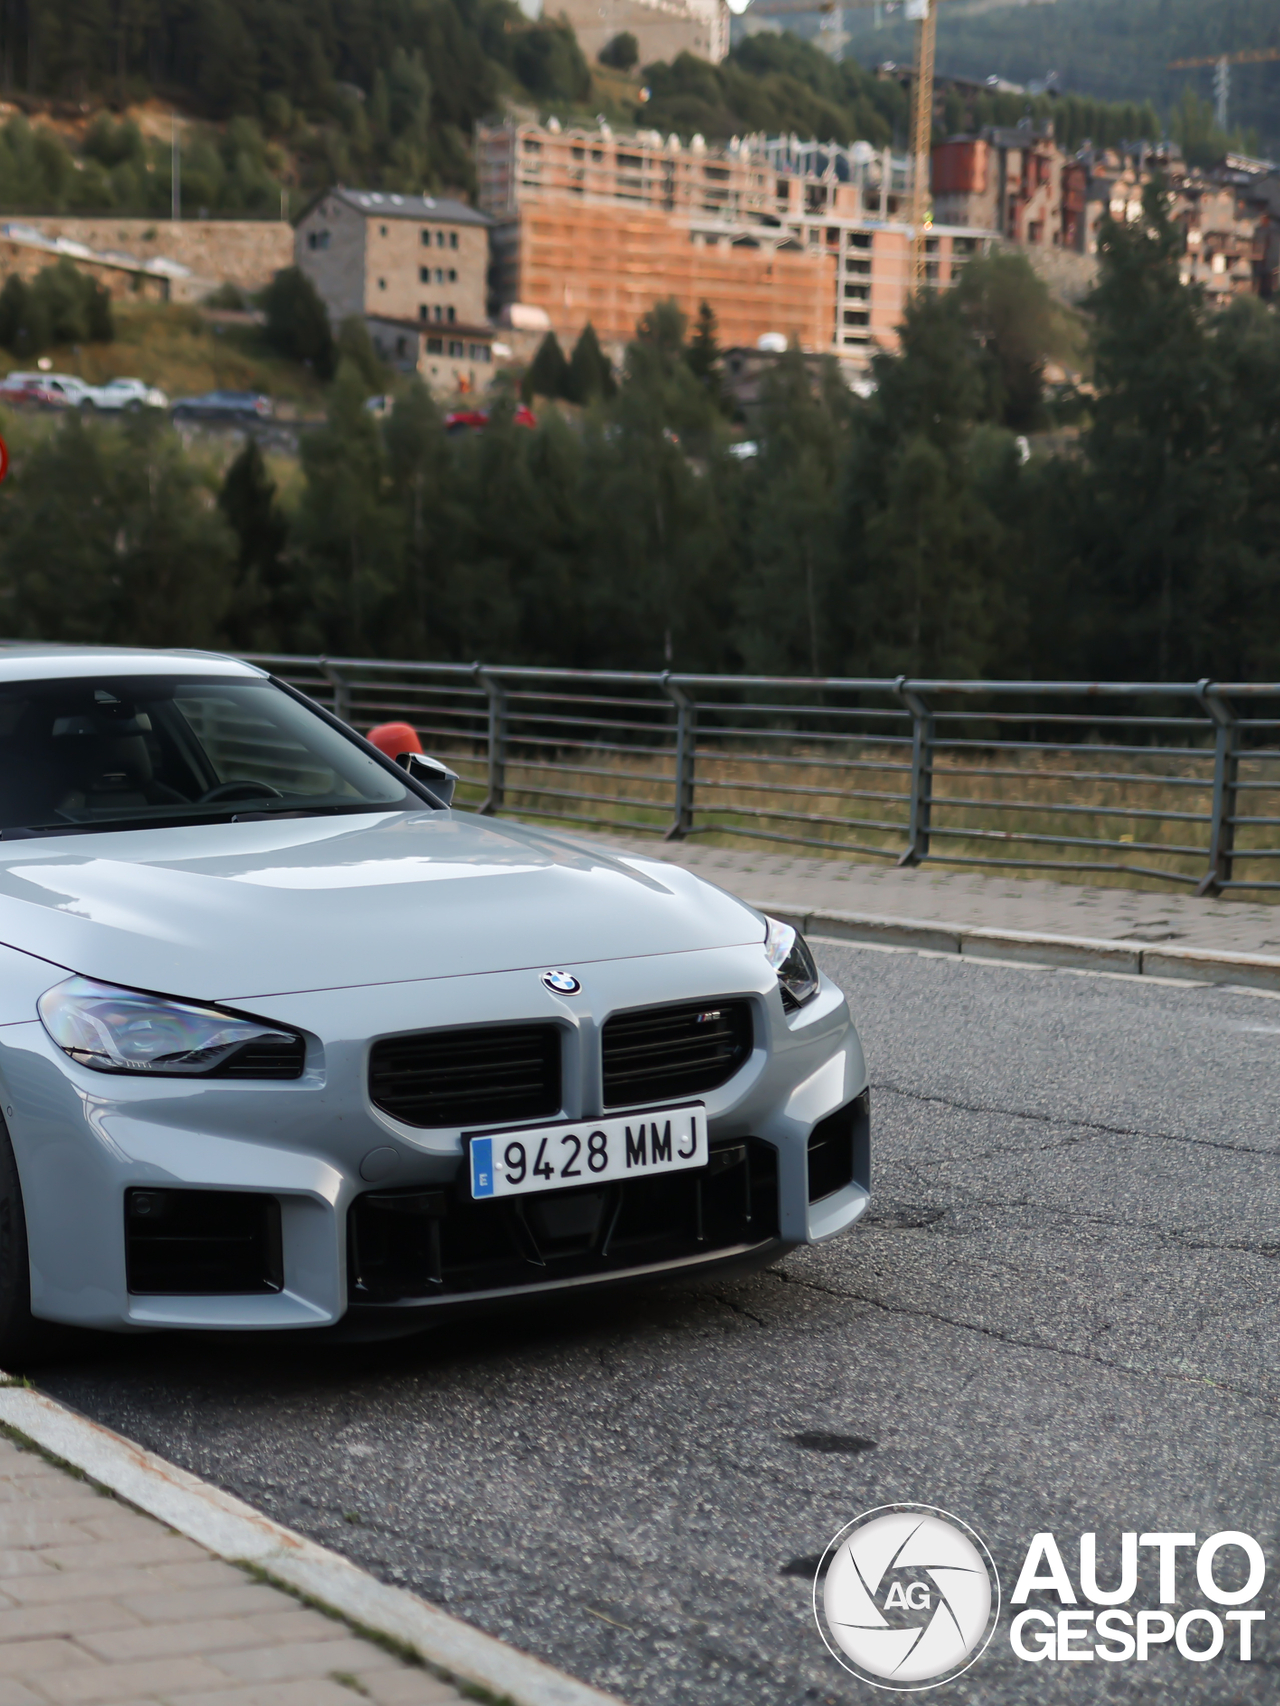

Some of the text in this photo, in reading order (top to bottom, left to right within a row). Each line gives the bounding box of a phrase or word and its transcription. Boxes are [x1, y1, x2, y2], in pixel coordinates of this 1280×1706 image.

[504, 1116, 697, 1185] 9428 MMJ
[479, 1173, 488, 1187] E
